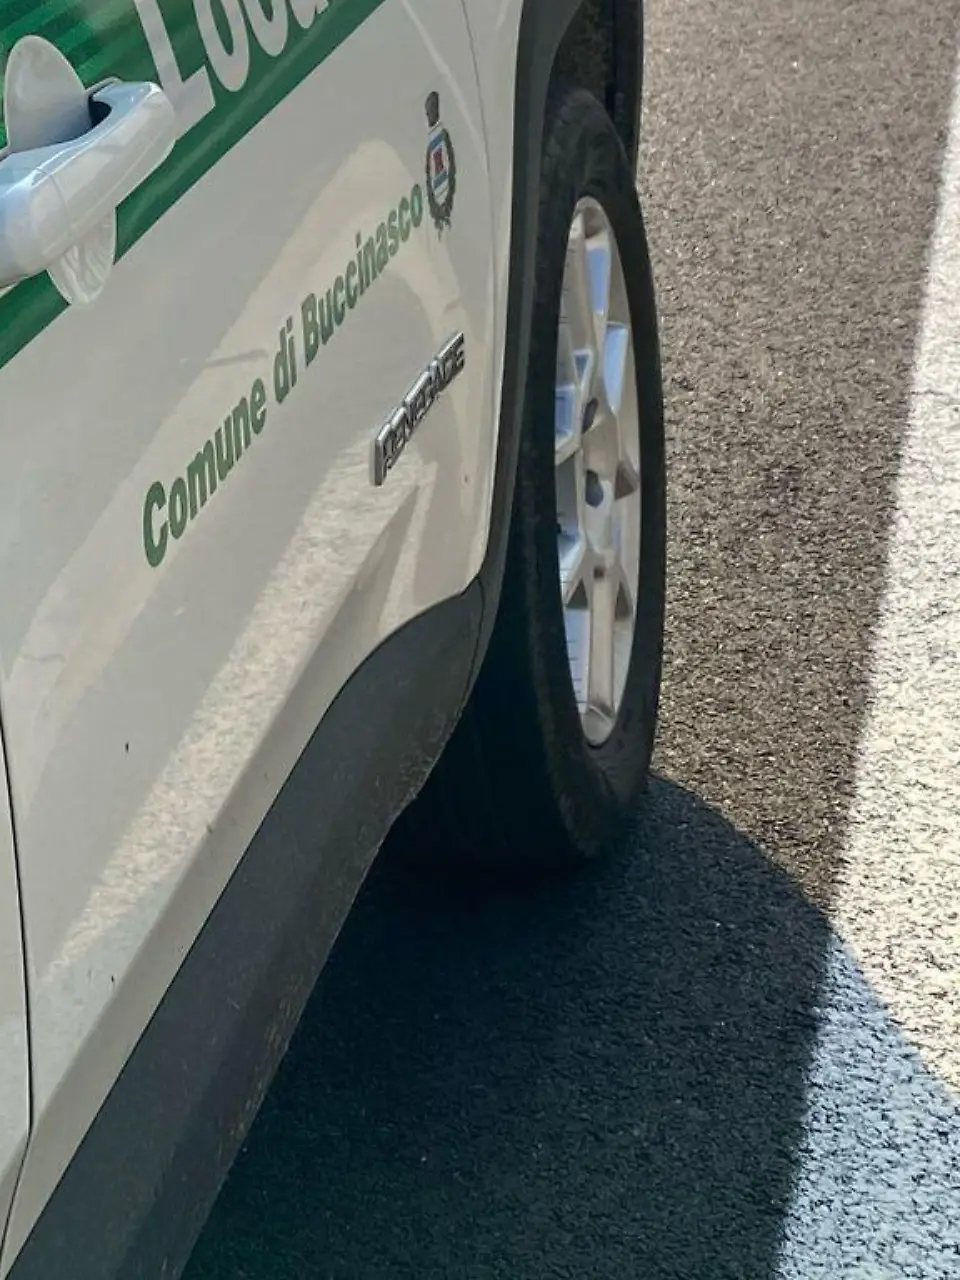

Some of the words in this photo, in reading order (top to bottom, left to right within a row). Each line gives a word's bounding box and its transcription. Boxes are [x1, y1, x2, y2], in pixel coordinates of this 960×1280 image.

[142, 377, 268, 568] Comune
[273, 315, 298, 405] di
[300, 183, 424, 369] Buccinasco
